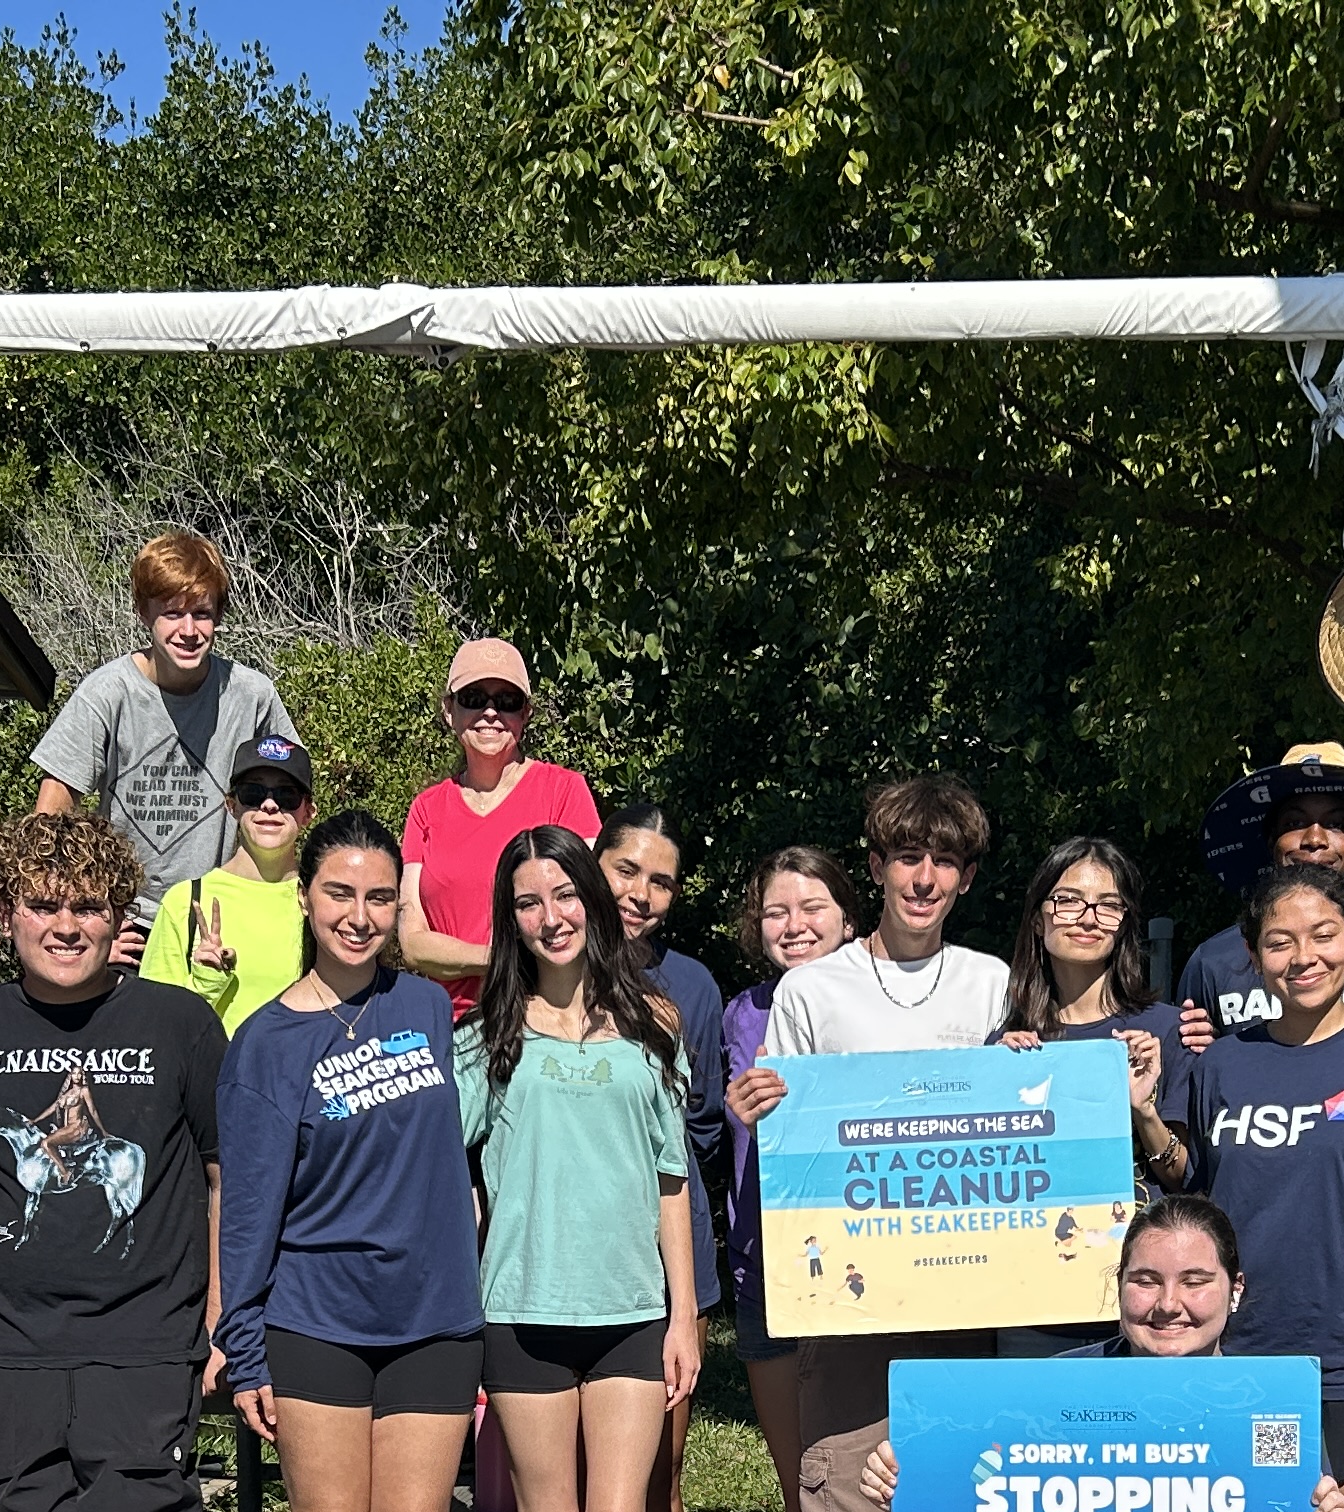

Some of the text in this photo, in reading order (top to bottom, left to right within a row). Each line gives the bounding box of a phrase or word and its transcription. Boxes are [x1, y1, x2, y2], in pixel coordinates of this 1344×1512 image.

[143, 765, 199, 777] YOU CAN
[133, 780, 166, 792] READ
[126, 791, 208, 808] WE ARE JUST
[133, 808, 199, 822] WARMING
[156, 824, 173, 836] UP
[312, 1037, 384, 1089] JUNIOR
[93, 1073, 155, 1085] WORLD TOUR
[346, 1066, 446, 1115] PROGRAM
[844, 1113, 1044, 1141] WE'RE KEEPING THE SEA
[1210, 1104, 1324, 1149] HSF
[846, 1143, 1047, 1173] AT A COASTAL
[843, 1169, 1051, 1212] CLEANUP
[842, 1209, 1048, 1238] WITH SEAKEEPERS
[913, 1254, 988, 1268] #SEAKEEPERS
[1060, 1409, 1137, 1423] SEAKEEPERS
[1009, 1443, 1210, 1465] SORRY, I'M BUSY
